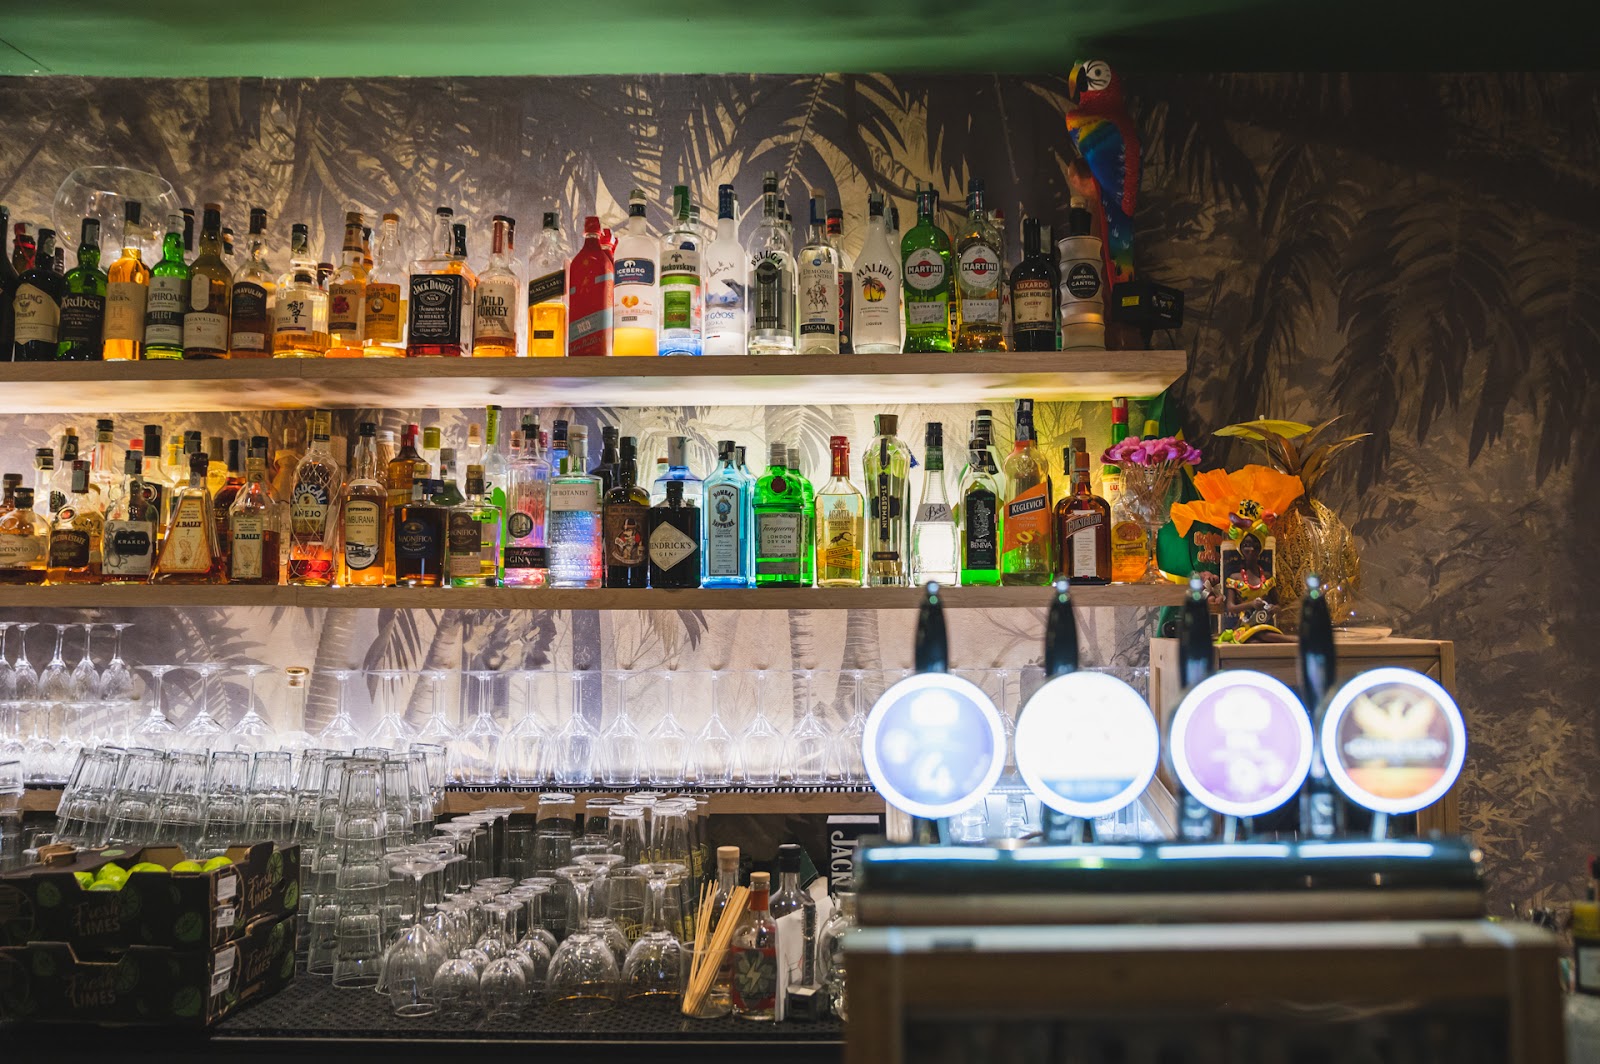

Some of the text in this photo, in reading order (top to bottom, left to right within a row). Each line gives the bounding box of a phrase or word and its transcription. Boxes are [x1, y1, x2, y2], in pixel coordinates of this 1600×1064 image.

[750, 250, 783, 266] BELUGA
[856, 263, 894, 281] MALIBU
[908, 265, 942, 274] MARTINI
[963, 263, 997, 272] MARTINI
[413, 282, 429, 295] JACK
[1016, 282, 1049, 290] LUXARDO
[480, 296, 504, 306] WILD
[152, 312, 172, 320] SELECT
[478, 305, 508, 318] TURKEY
[576, 320, 592, 334] RED
[712, 489, 734, 500] BOMBAY
[1012, 498, 1043, 514] KEGLEVICH
[294, 508, 322, 518] AÑEJO
[830, 830, 859, 886] JACK
